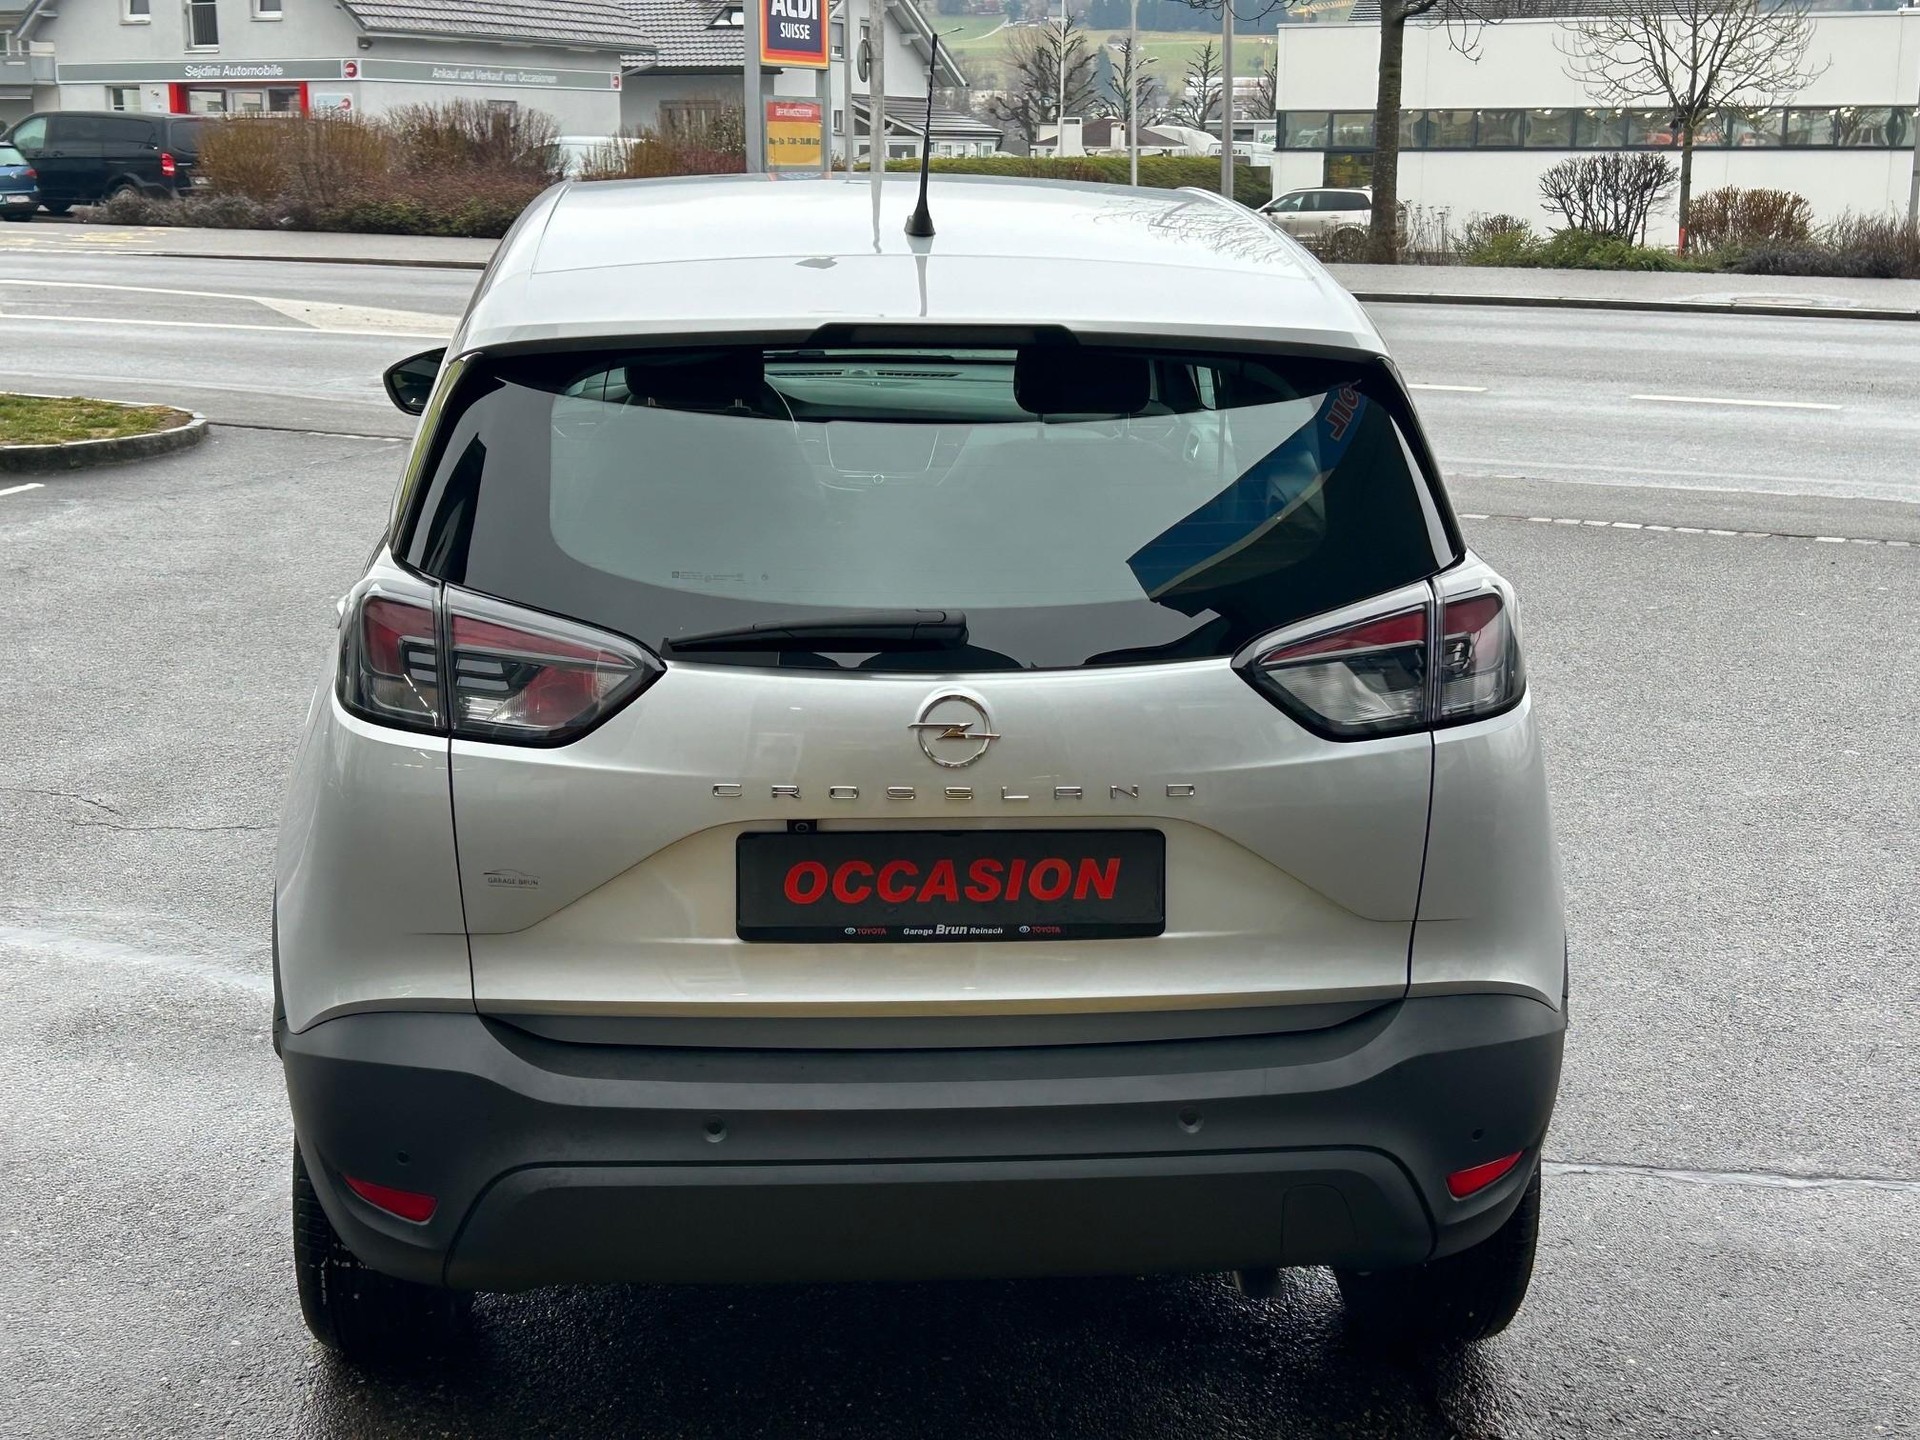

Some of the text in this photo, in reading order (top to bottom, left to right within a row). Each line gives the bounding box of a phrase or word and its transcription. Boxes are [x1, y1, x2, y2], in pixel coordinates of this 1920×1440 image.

[770, 0, 818, 20] ALDI
[780, 22, 811, 40] SUISSE
[184, 63, 284, 79] Sejdini Automobile
[711, 782, 1196, 801] CROSSLAND
[783, 857, 1121, 905] OCCASION
[903, 924, 1003, 936] Garage Brun Reinach
[1031, 926, 1061, 934] TOYOTA
